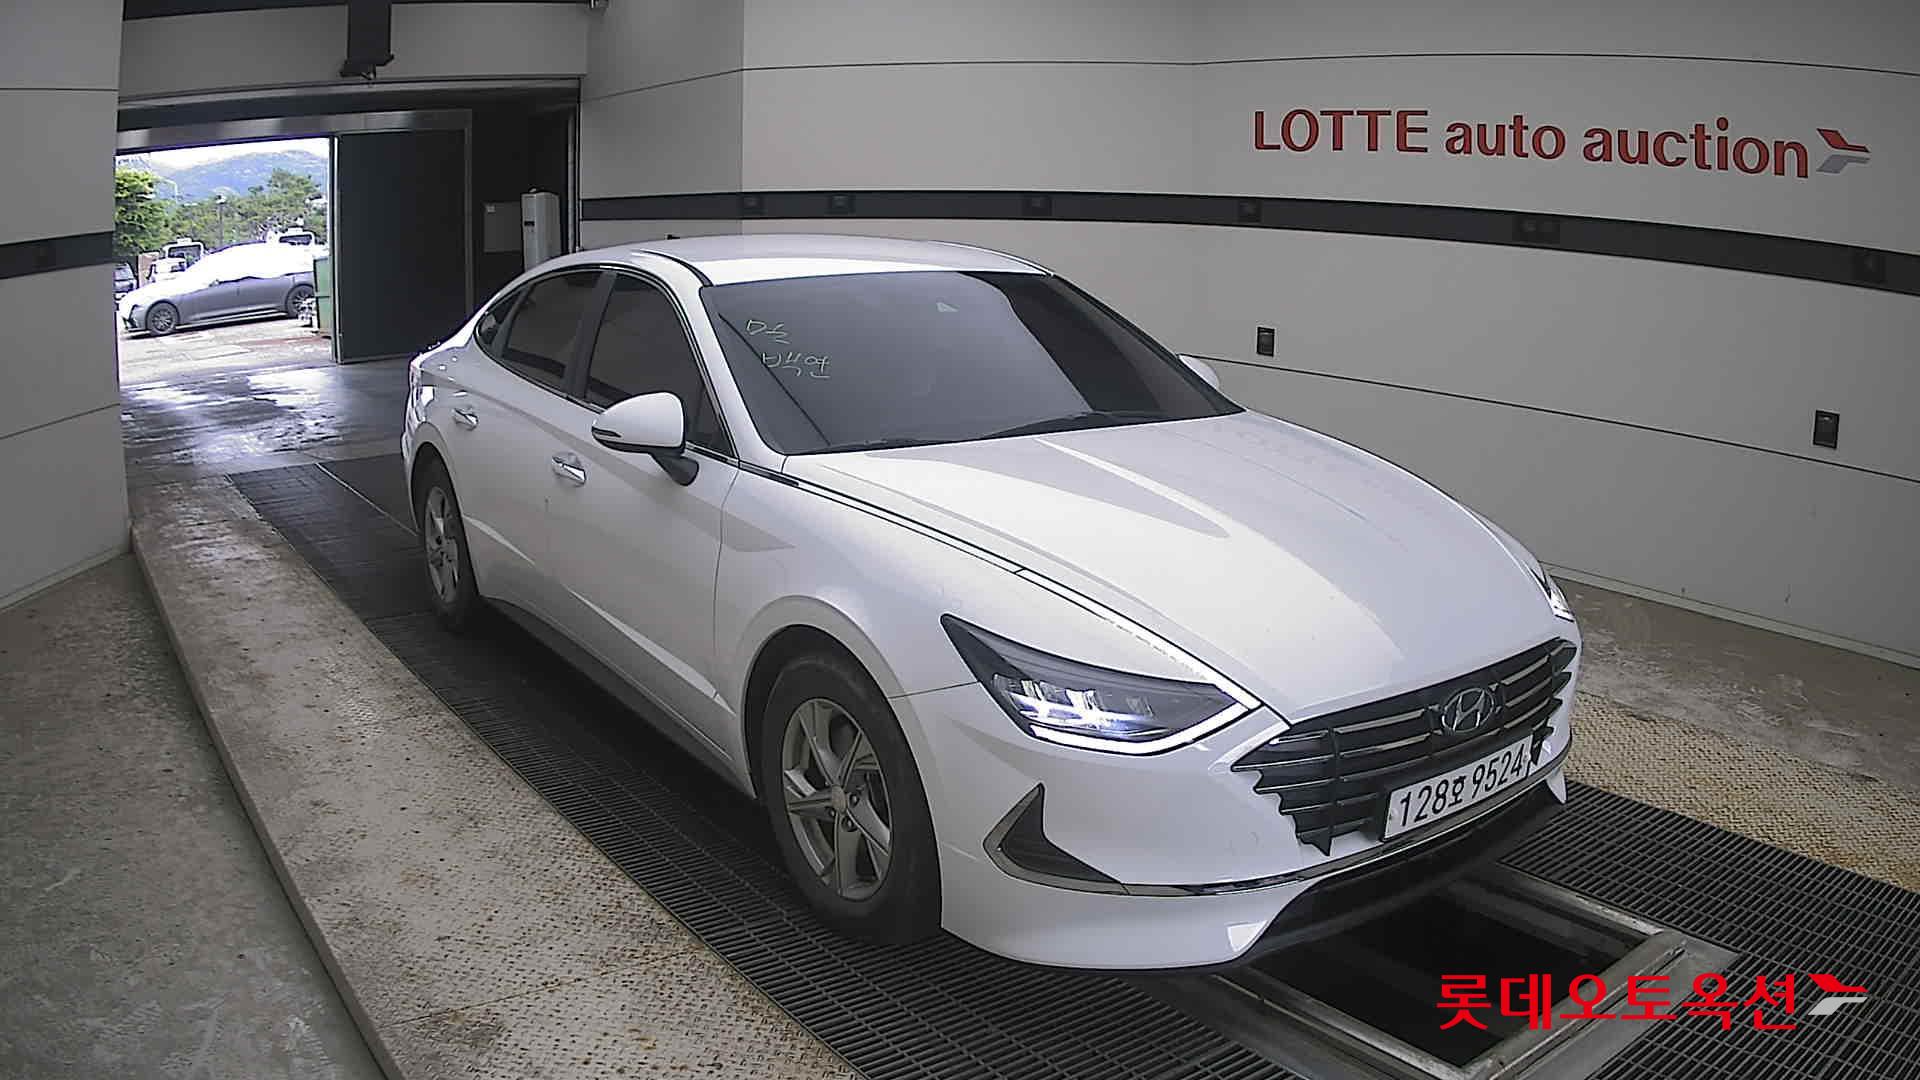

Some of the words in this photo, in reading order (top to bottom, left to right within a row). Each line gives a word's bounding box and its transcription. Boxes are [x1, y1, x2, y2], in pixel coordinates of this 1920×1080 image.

[1254, 110, 1429, 153] LOTTE
[1445, 115, 1566, 160] auto
[1583, 117, 1809, 179] auction
[1472, 744, 1526, 799] 9524
